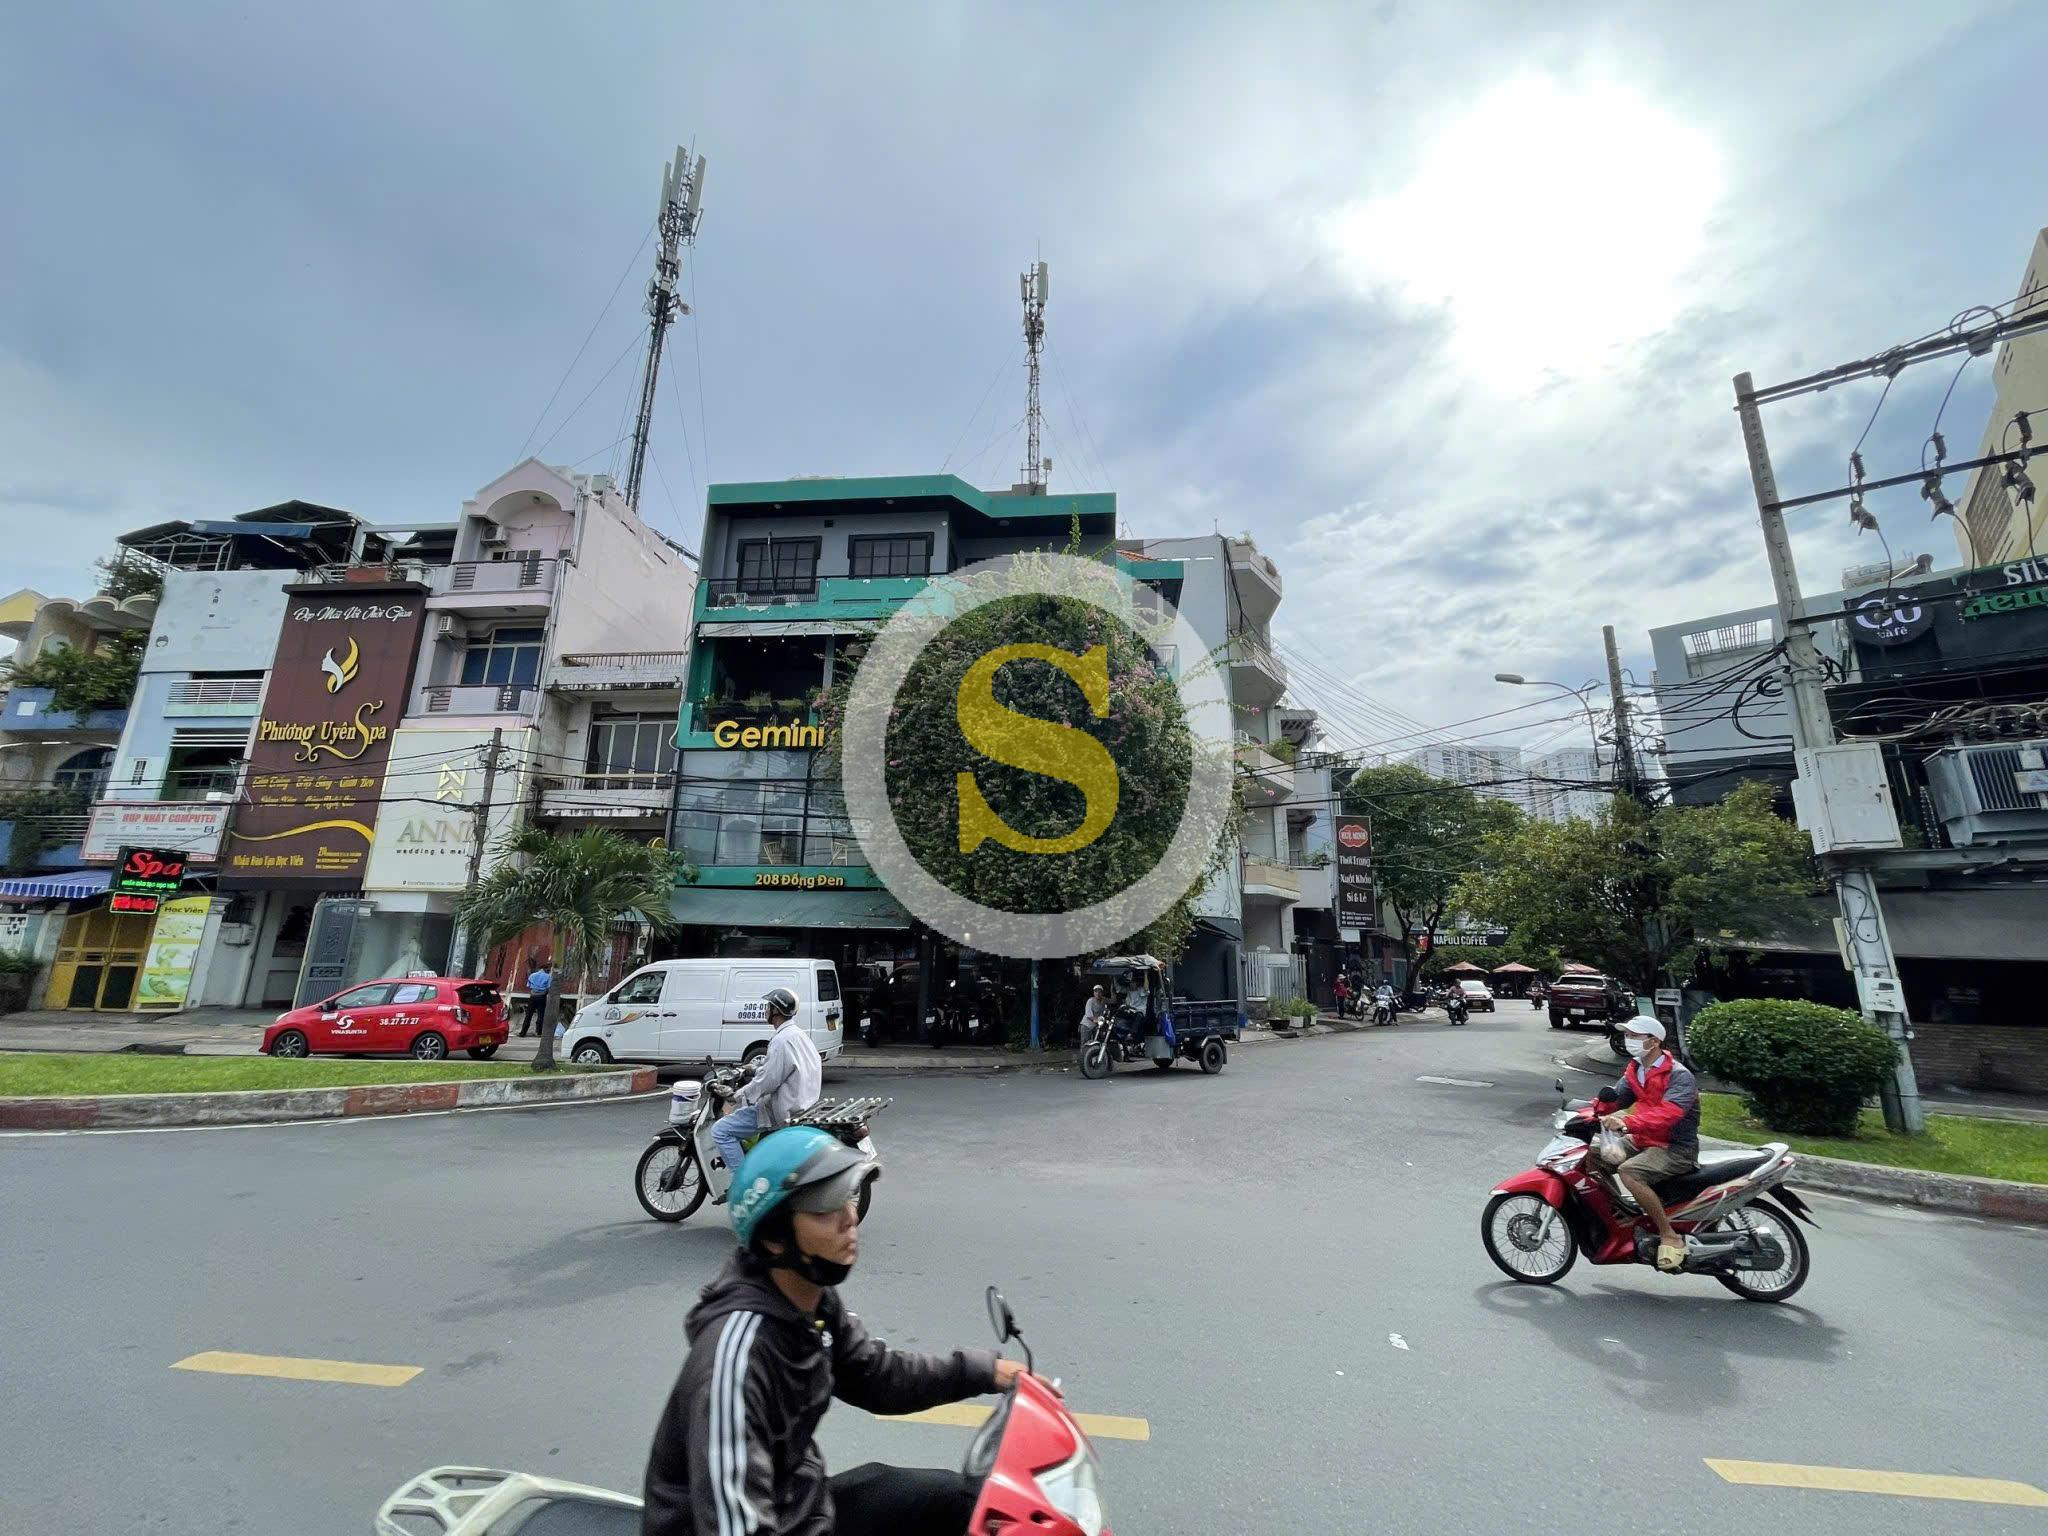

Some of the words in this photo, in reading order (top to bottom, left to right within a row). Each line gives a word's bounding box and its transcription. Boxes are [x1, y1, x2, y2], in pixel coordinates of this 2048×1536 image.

[260, 718, 316, 761] Phương
[320, 720, 357, 745] Uyên
[714, 718, 825, 749] Gemini
[168, 813, 217, 824] COMPUTER
[396, 848, 435, 856] wedding
[124, 852, 182, 878] Spa
[755, 873, 779, 886] 208
[781, 872, 815, 888] Đồng
[817, 874, 844, 886] Đen
[1433, 935, 1460, 945] NAPOLI
[1460, 935, 1488, 946] COFFEE
